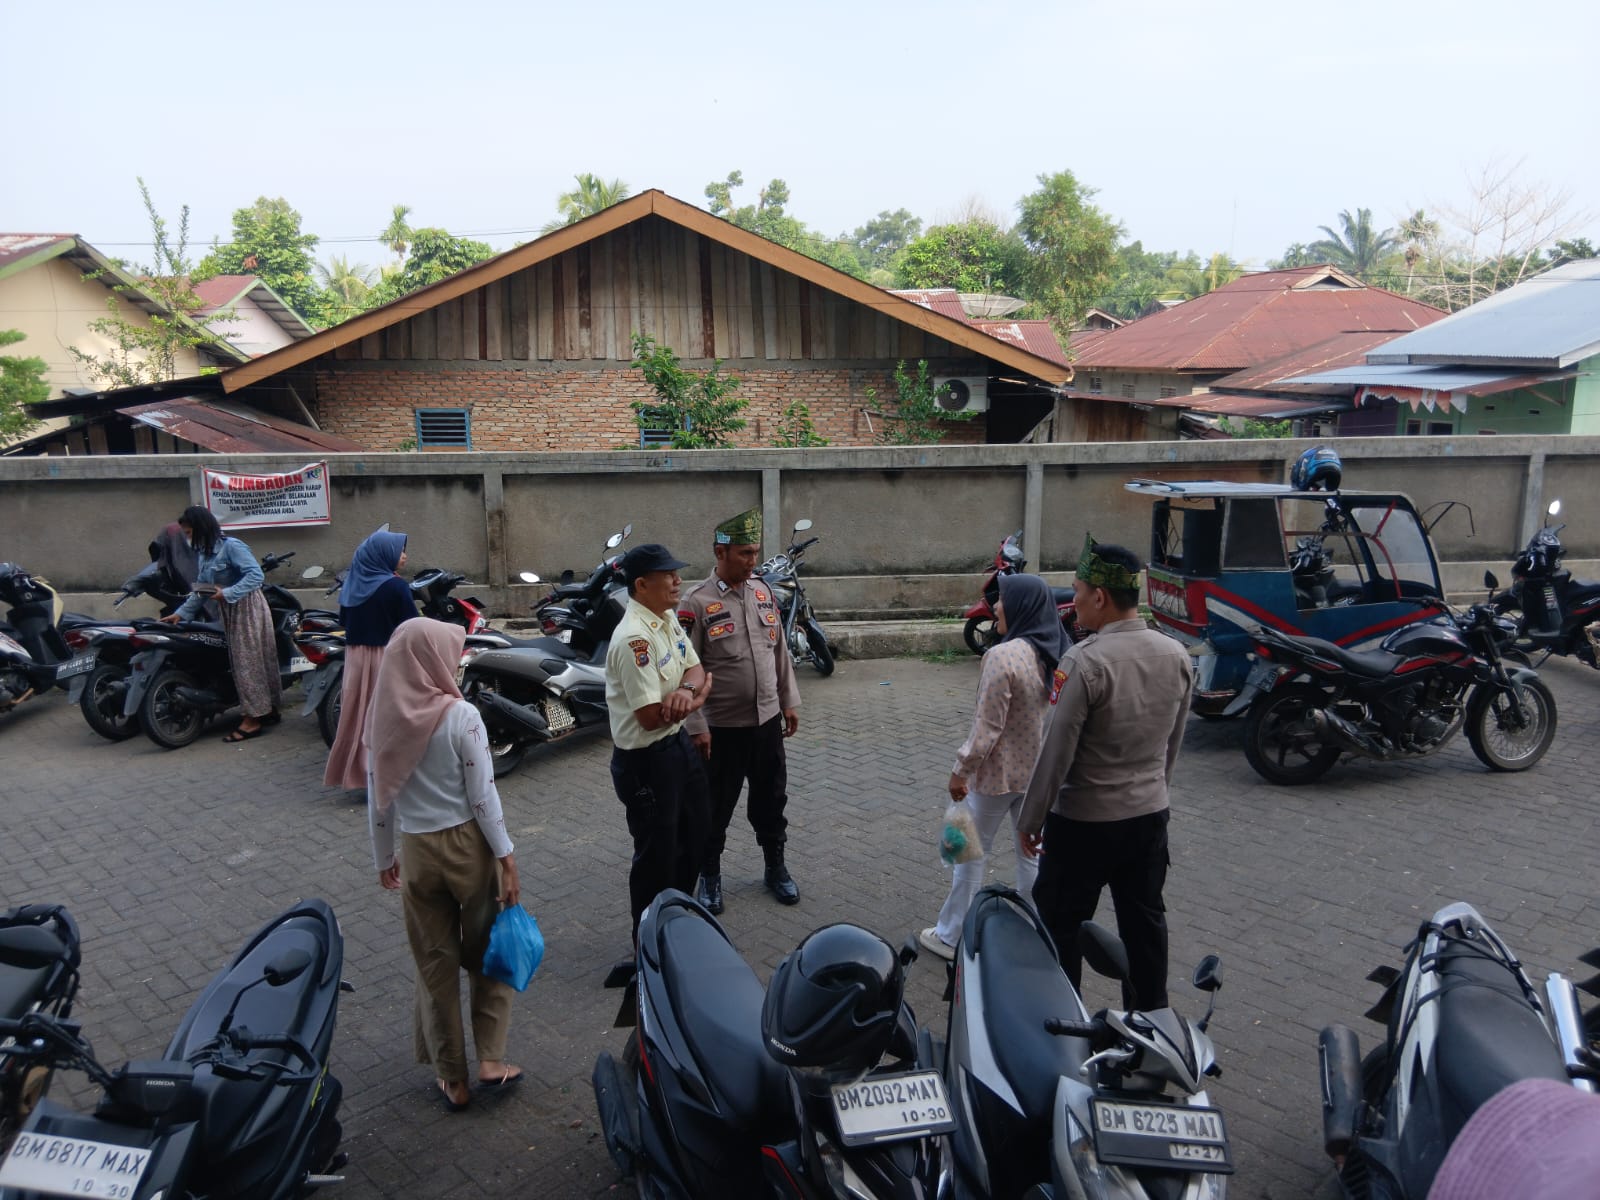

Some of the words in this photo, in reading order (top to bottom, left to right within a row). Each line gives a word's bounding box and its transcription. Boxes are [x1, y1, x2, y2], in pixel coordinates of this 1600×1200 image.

[228, 474, 303, 491] HIMBAUAN
[770, 1037, 797, 1056] HONDA
[146, 1079, 176, 1087] HONDA
[1101, 1106, 1126, 1129] BM
[1132, 1109, 1179, 1134] 6225
[12, 1136, 47, 1159] BM
[46, 1140, 97, 1168] 6817
[100, 1149, 146, 1176] MAX
